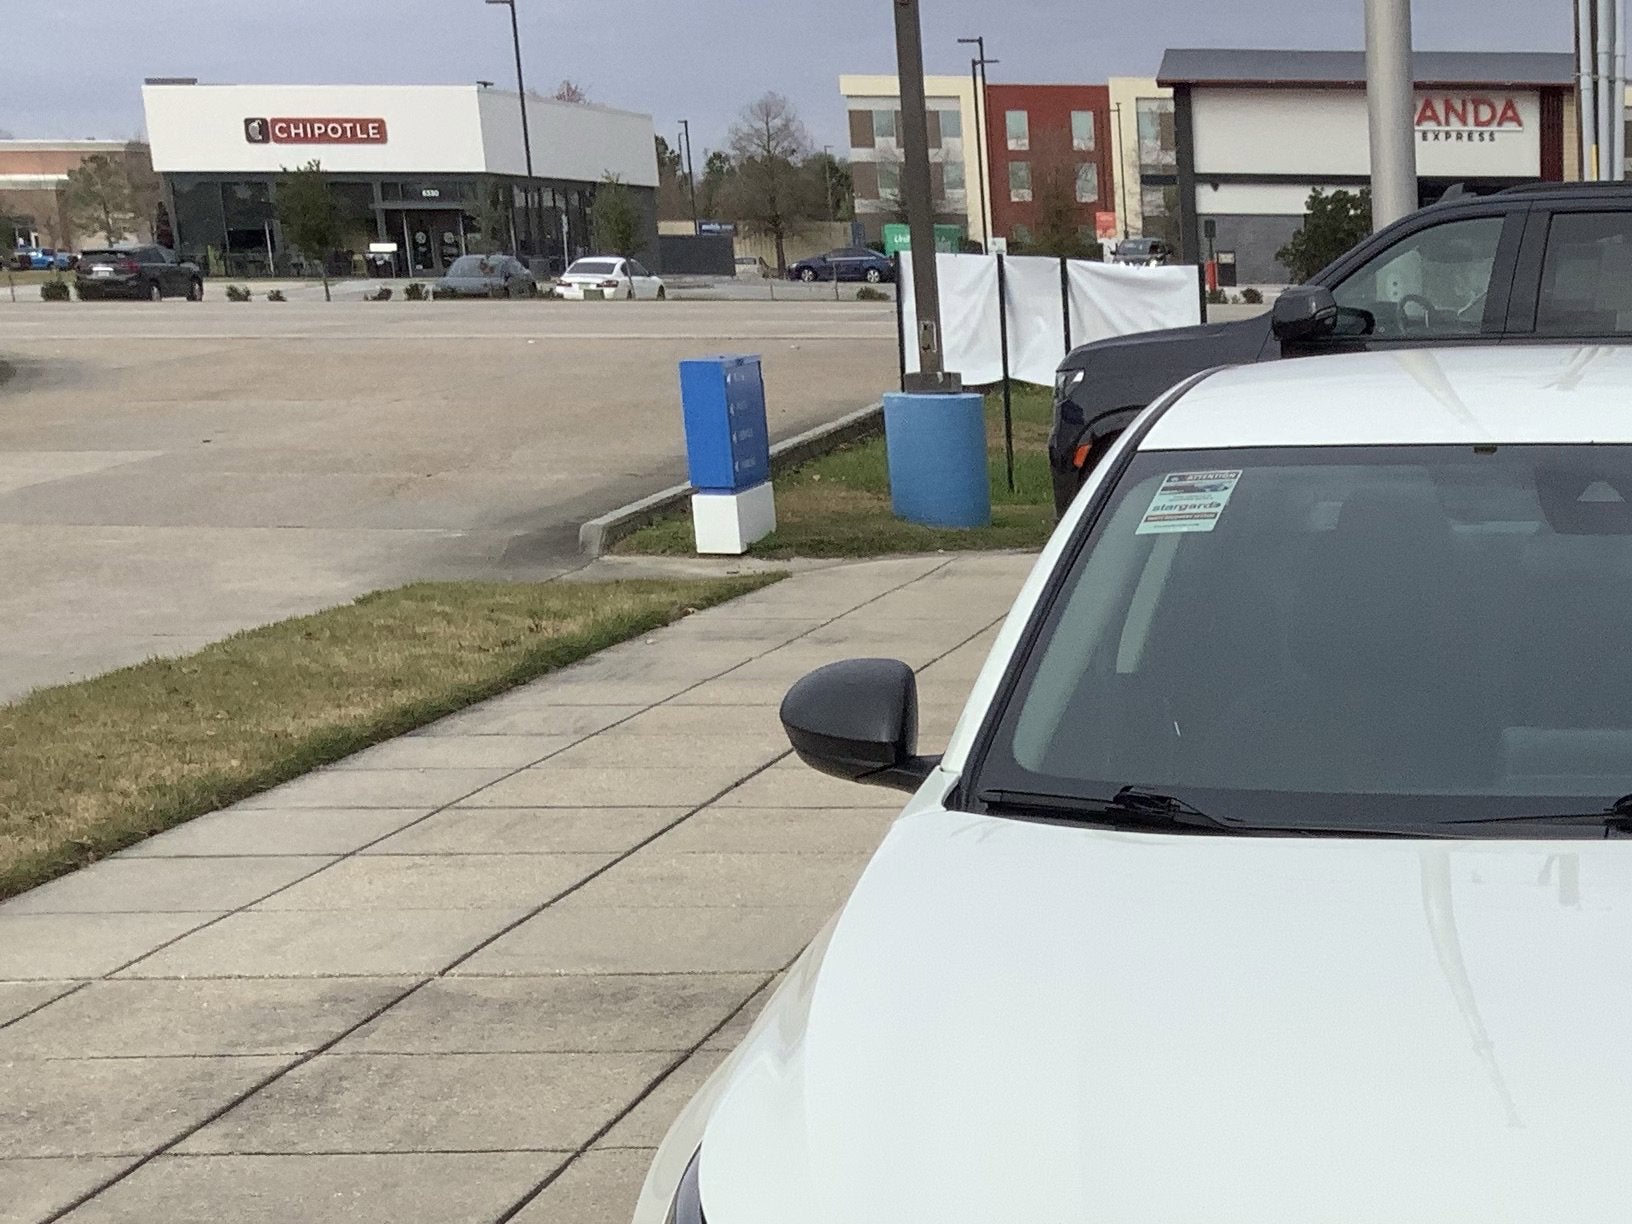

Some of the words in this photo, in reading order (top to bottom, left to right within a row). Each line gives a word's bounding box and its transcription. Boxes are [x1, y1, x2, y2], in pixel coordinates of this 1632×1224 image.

[1414, 97, 1523, 128] ANDA
[275, 122, 380, 138] CHIPOTLE
[1422, 130, 1496, 142] EXPRESS
